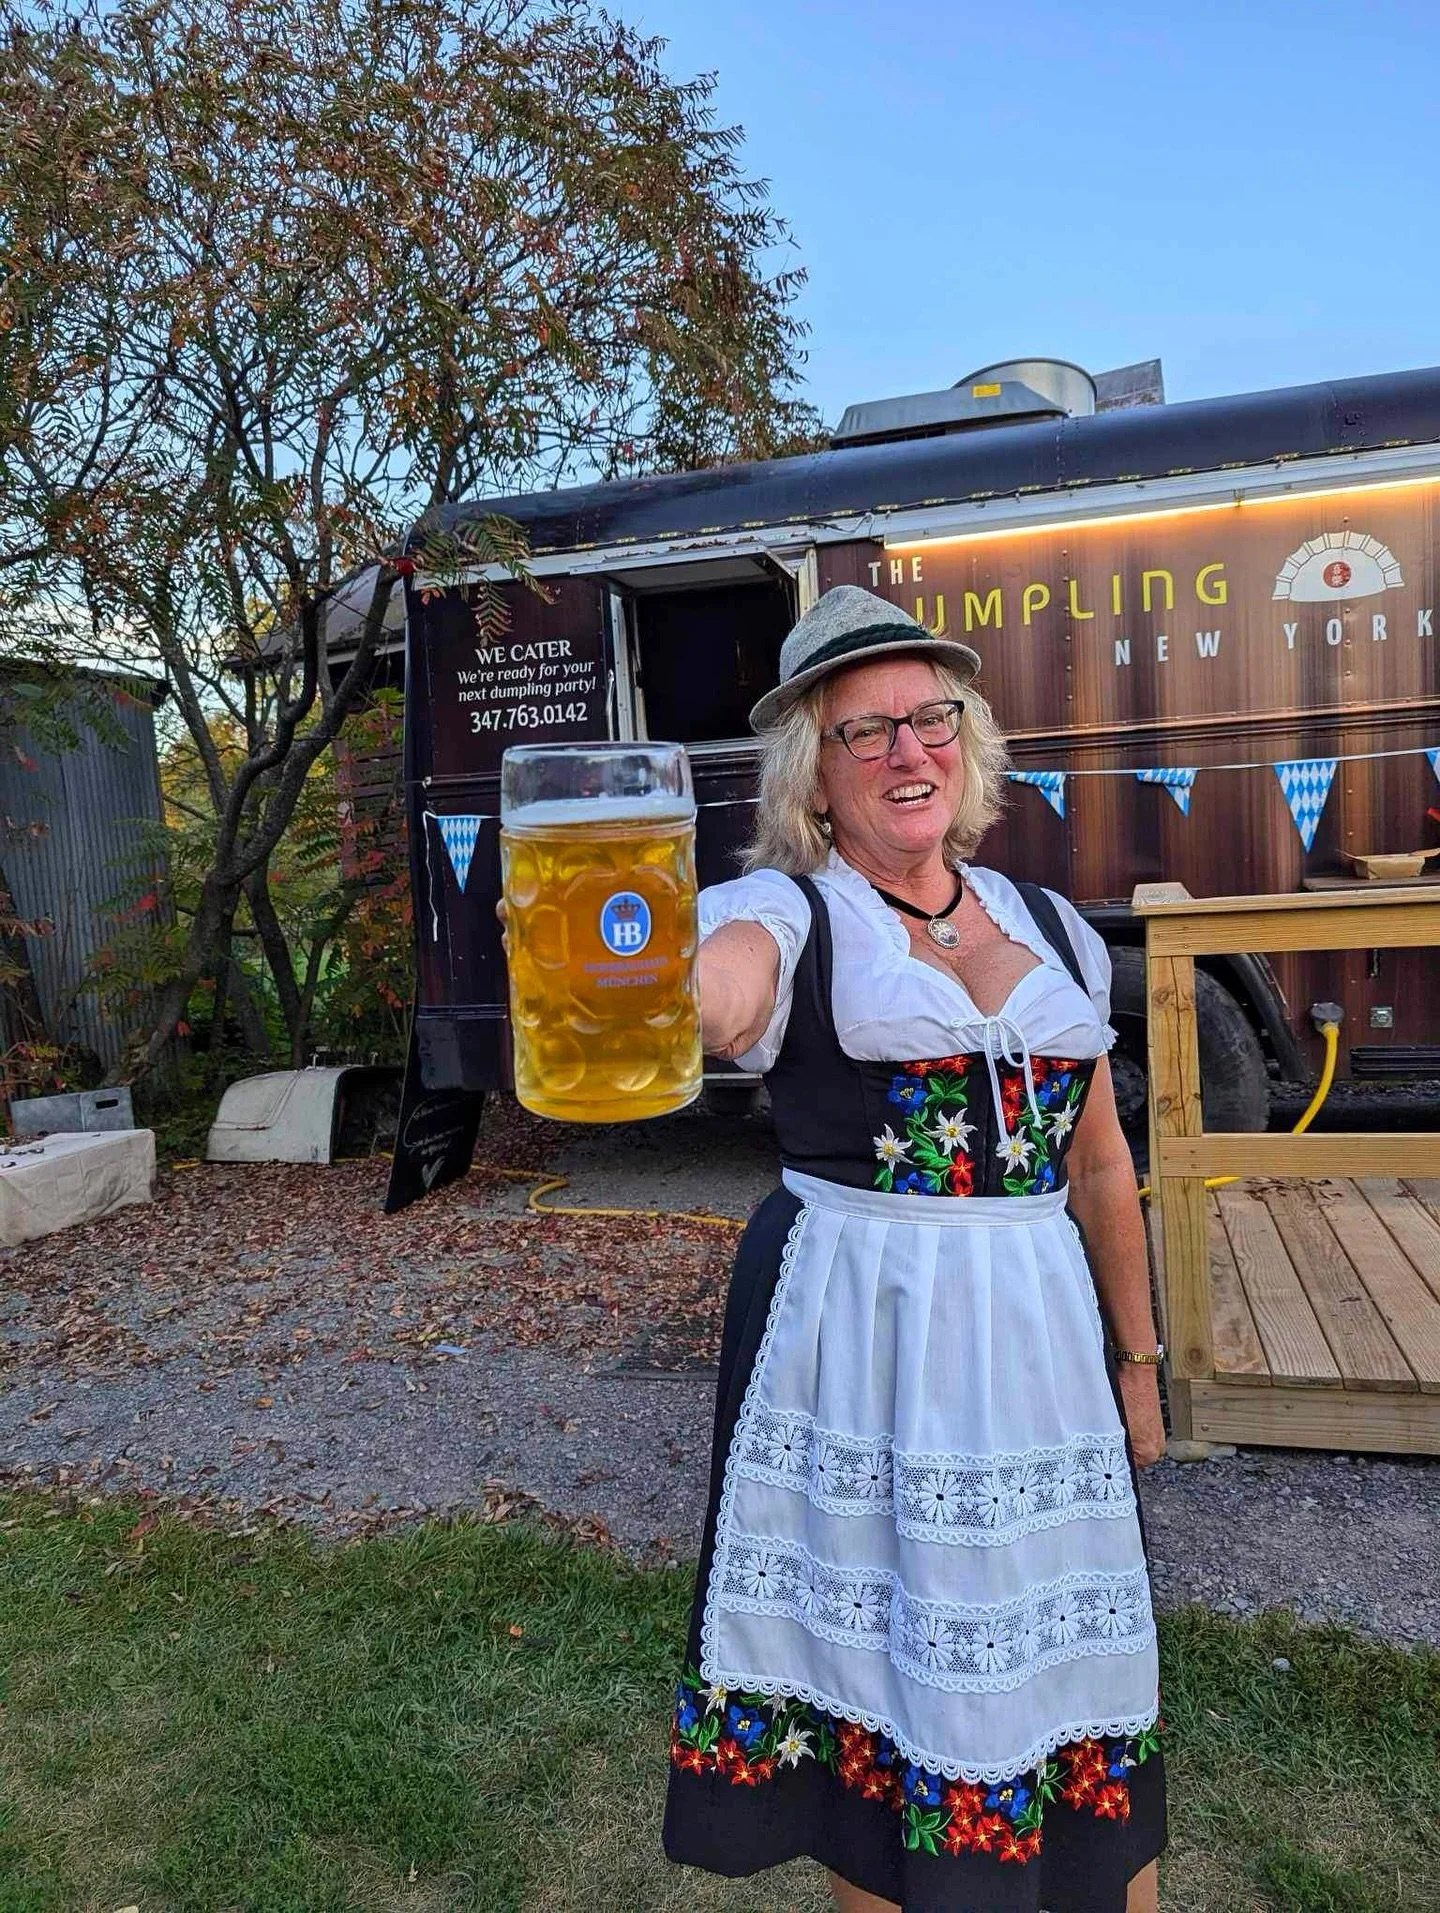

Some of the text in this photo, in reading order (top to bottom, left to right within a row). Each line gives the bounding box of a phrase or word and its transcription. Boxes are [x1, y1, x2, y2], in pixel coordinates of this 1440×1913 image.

[868, 556, 923, 588] THE
[916, 563, 1227, 638] UMPLING
[1114, 609, 1433, 666] NEW YORK
[475, 640, 572, 664] WE CATER
[457, 661, 595, 684] We're ready for your
[459, 676, 597, 702] next dumpling party!
[470, 702, 588, 733] 347.763.0142
[613, 921, 642, 946] HB
